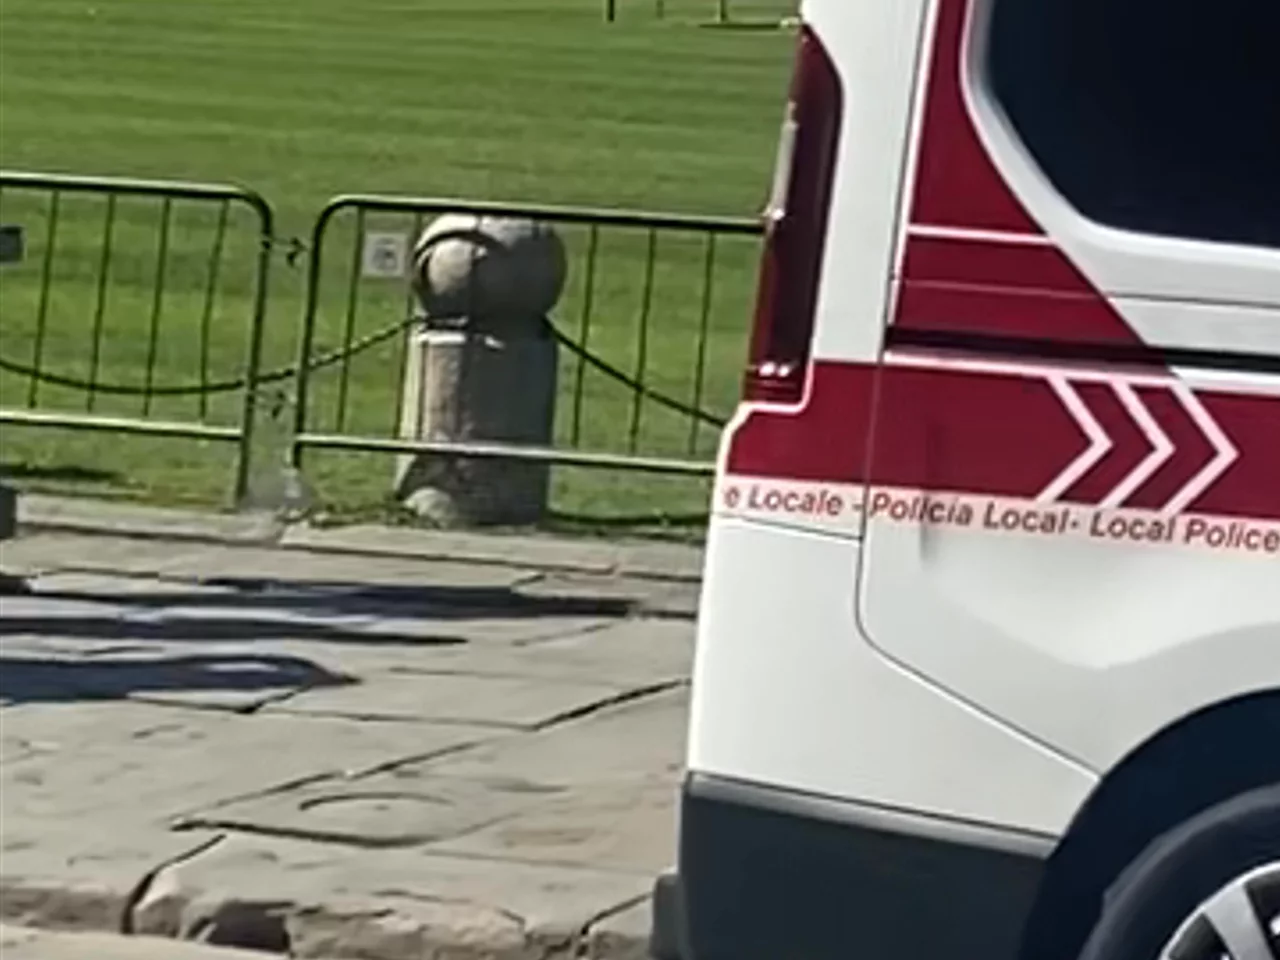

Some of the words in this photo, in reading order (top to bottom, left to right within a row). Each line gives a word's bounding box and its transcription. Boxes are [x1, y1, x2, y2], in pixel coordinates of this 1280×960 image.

[748, 485, 843, 516] Locale
[1090, 512, 1177, 542] Local
[1184, 518, 1280, 552] Police
